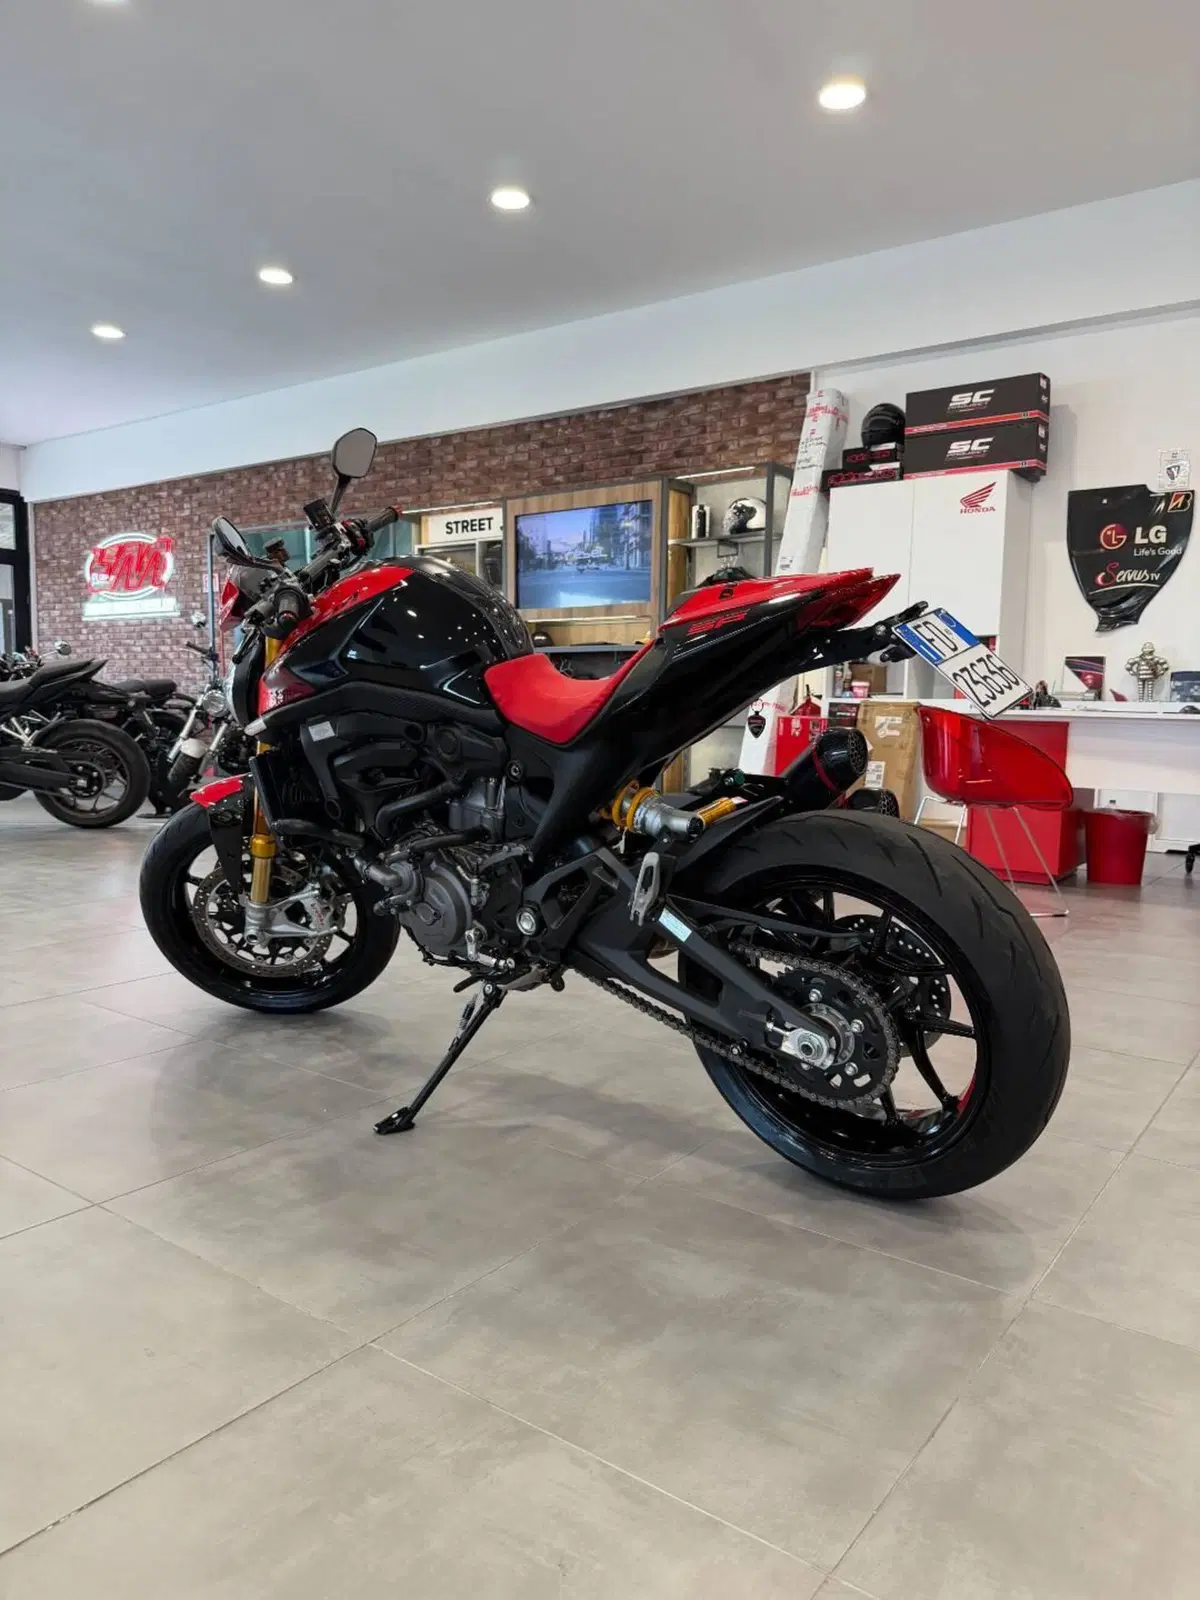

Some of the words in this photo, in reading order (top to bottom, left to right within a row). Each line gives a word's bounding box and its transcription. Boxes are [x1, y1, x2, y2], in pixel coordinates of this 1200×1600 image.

[949, 389, 995, 407] SC
[947, 437, 994, 455] SC
[960, 506, 996, 514] HONDA
[445, 517, 494, 535] STREET
[1135, 525, 1167, 544] LG
[1134, 547, 1156, 557] Life's
[1158, 547, 1182, 556] Good
[913, 620, 959, 657] FD
[952, 654, 1020, 708] 23636
